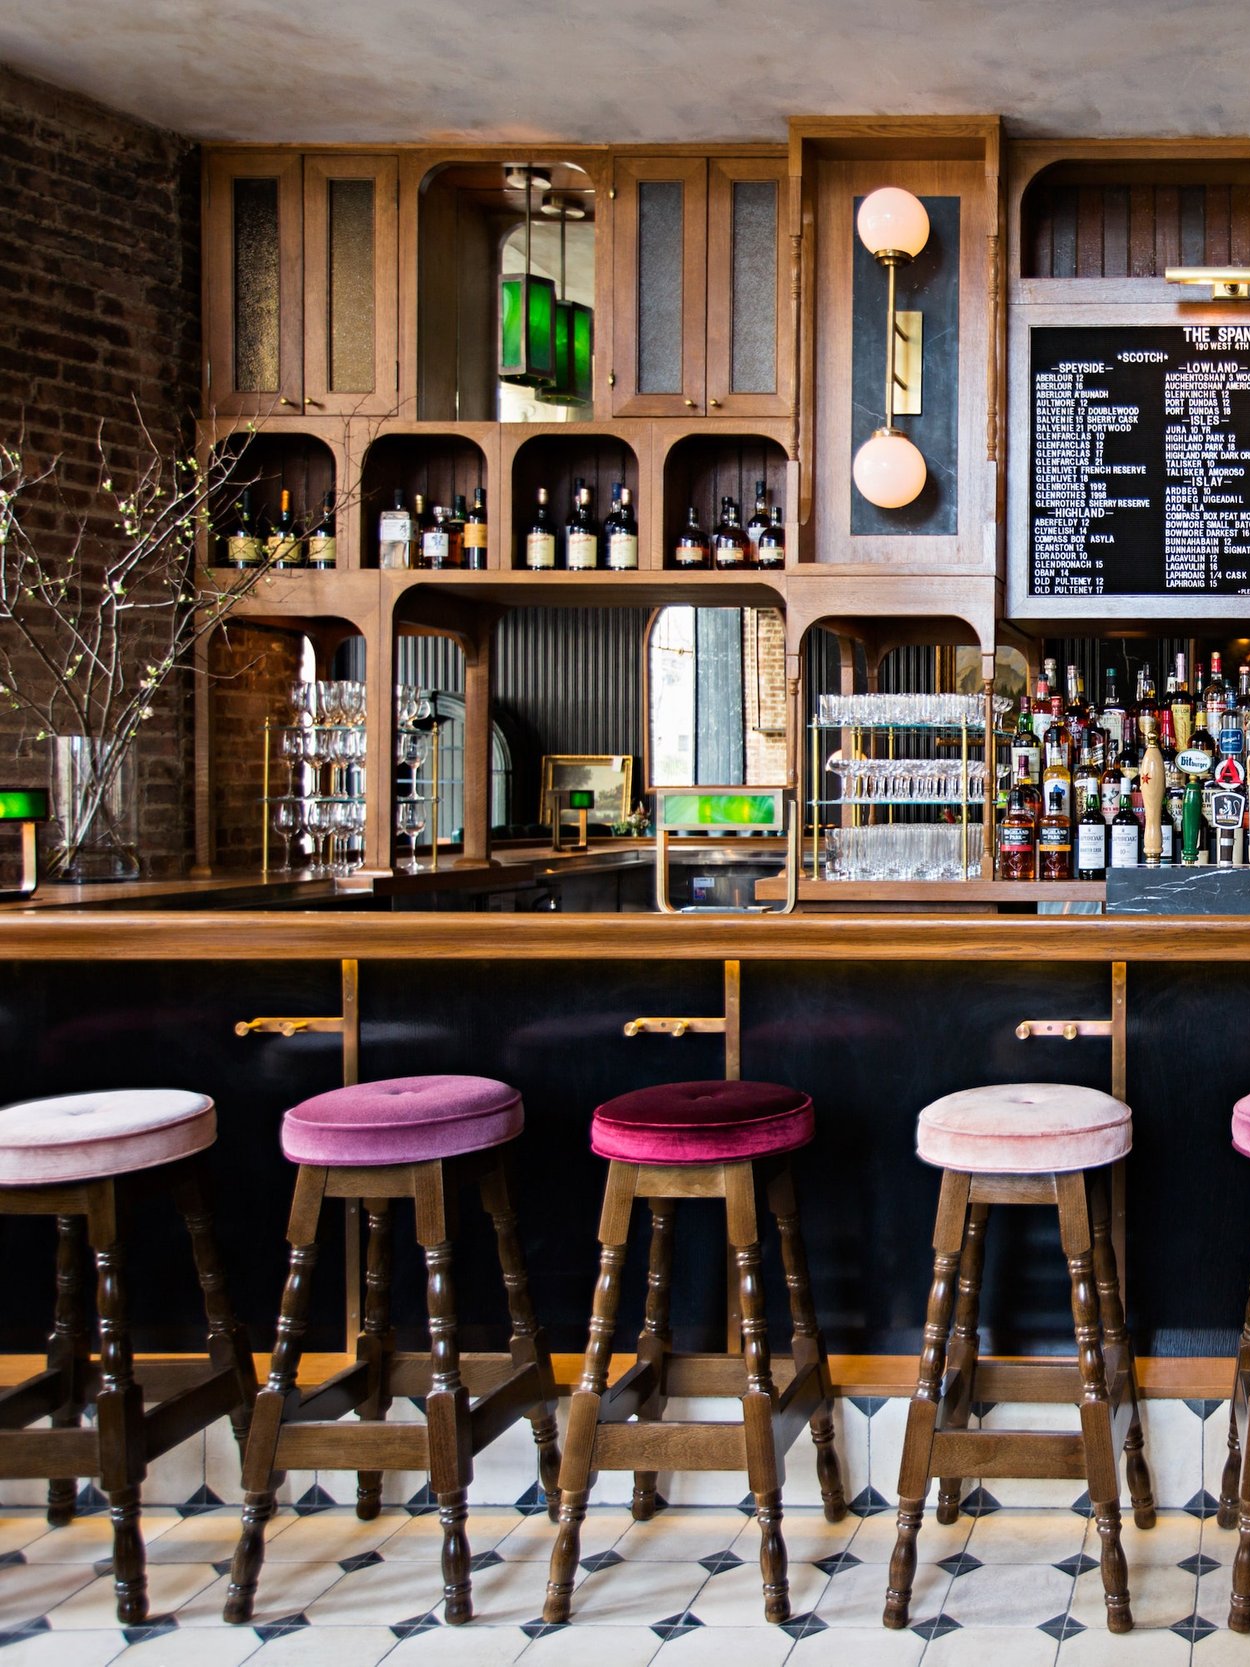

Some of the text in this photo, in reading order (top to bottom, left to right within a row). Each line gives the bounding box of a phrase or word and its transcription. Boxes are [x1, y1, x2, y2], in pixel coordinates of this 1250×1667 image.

[1183, 327, 1210, 342] THE
[1122, 352, 1163, 363] SCOTCH
[1059, 363, 1105, 374] SPEYSIDE
[1187, 363, 1238, 373] LOWLAND
[1036, 374, 1084, 382] ABERLOUR 12
[1165, 382, 1222, 390] AUCHENTOSHAN
[1036, 390, 1108, 398] ABERLOUR A'BUNADH
[1190, 415, 1220, 426] ISLES
[1166, 452, 1200, 460] HIGHLAND
[1201, 451, 1218, 460] PARK
[1220, 451, 1239, 460] DARK
[1036, 466, 1146, 474] GLENLIVET FRENCH RESERVE
[1166, 468, 1244, 476] TALISKER AMOROSO
[1192, 477, 1223, 487] ISLAY
[1089, 499, 1117, 507] SHERRY
[1118, 499, 1150, 507] RESERVE
[1166, 495, 1244, 503] ARDBEG UIGEADAIL
[1165, 504, 1204, 512] CAOL ILA
[1055, 508, 1105, 518] HIGHLAND
[1166, 512, 1200, 520] COMPASS
[1203, 512, 1218, 520] BOX
[1220, 512, 1238, 520] PEAT
[1166, 520, 1204, 528] BOWMORE
[1206, 520, 1229, 528] SMALL
[1034, 535, 1114, 543] COMPASS BOX ASYLA
[1165, 546, 1219, 554] BUNNAHABAIN
